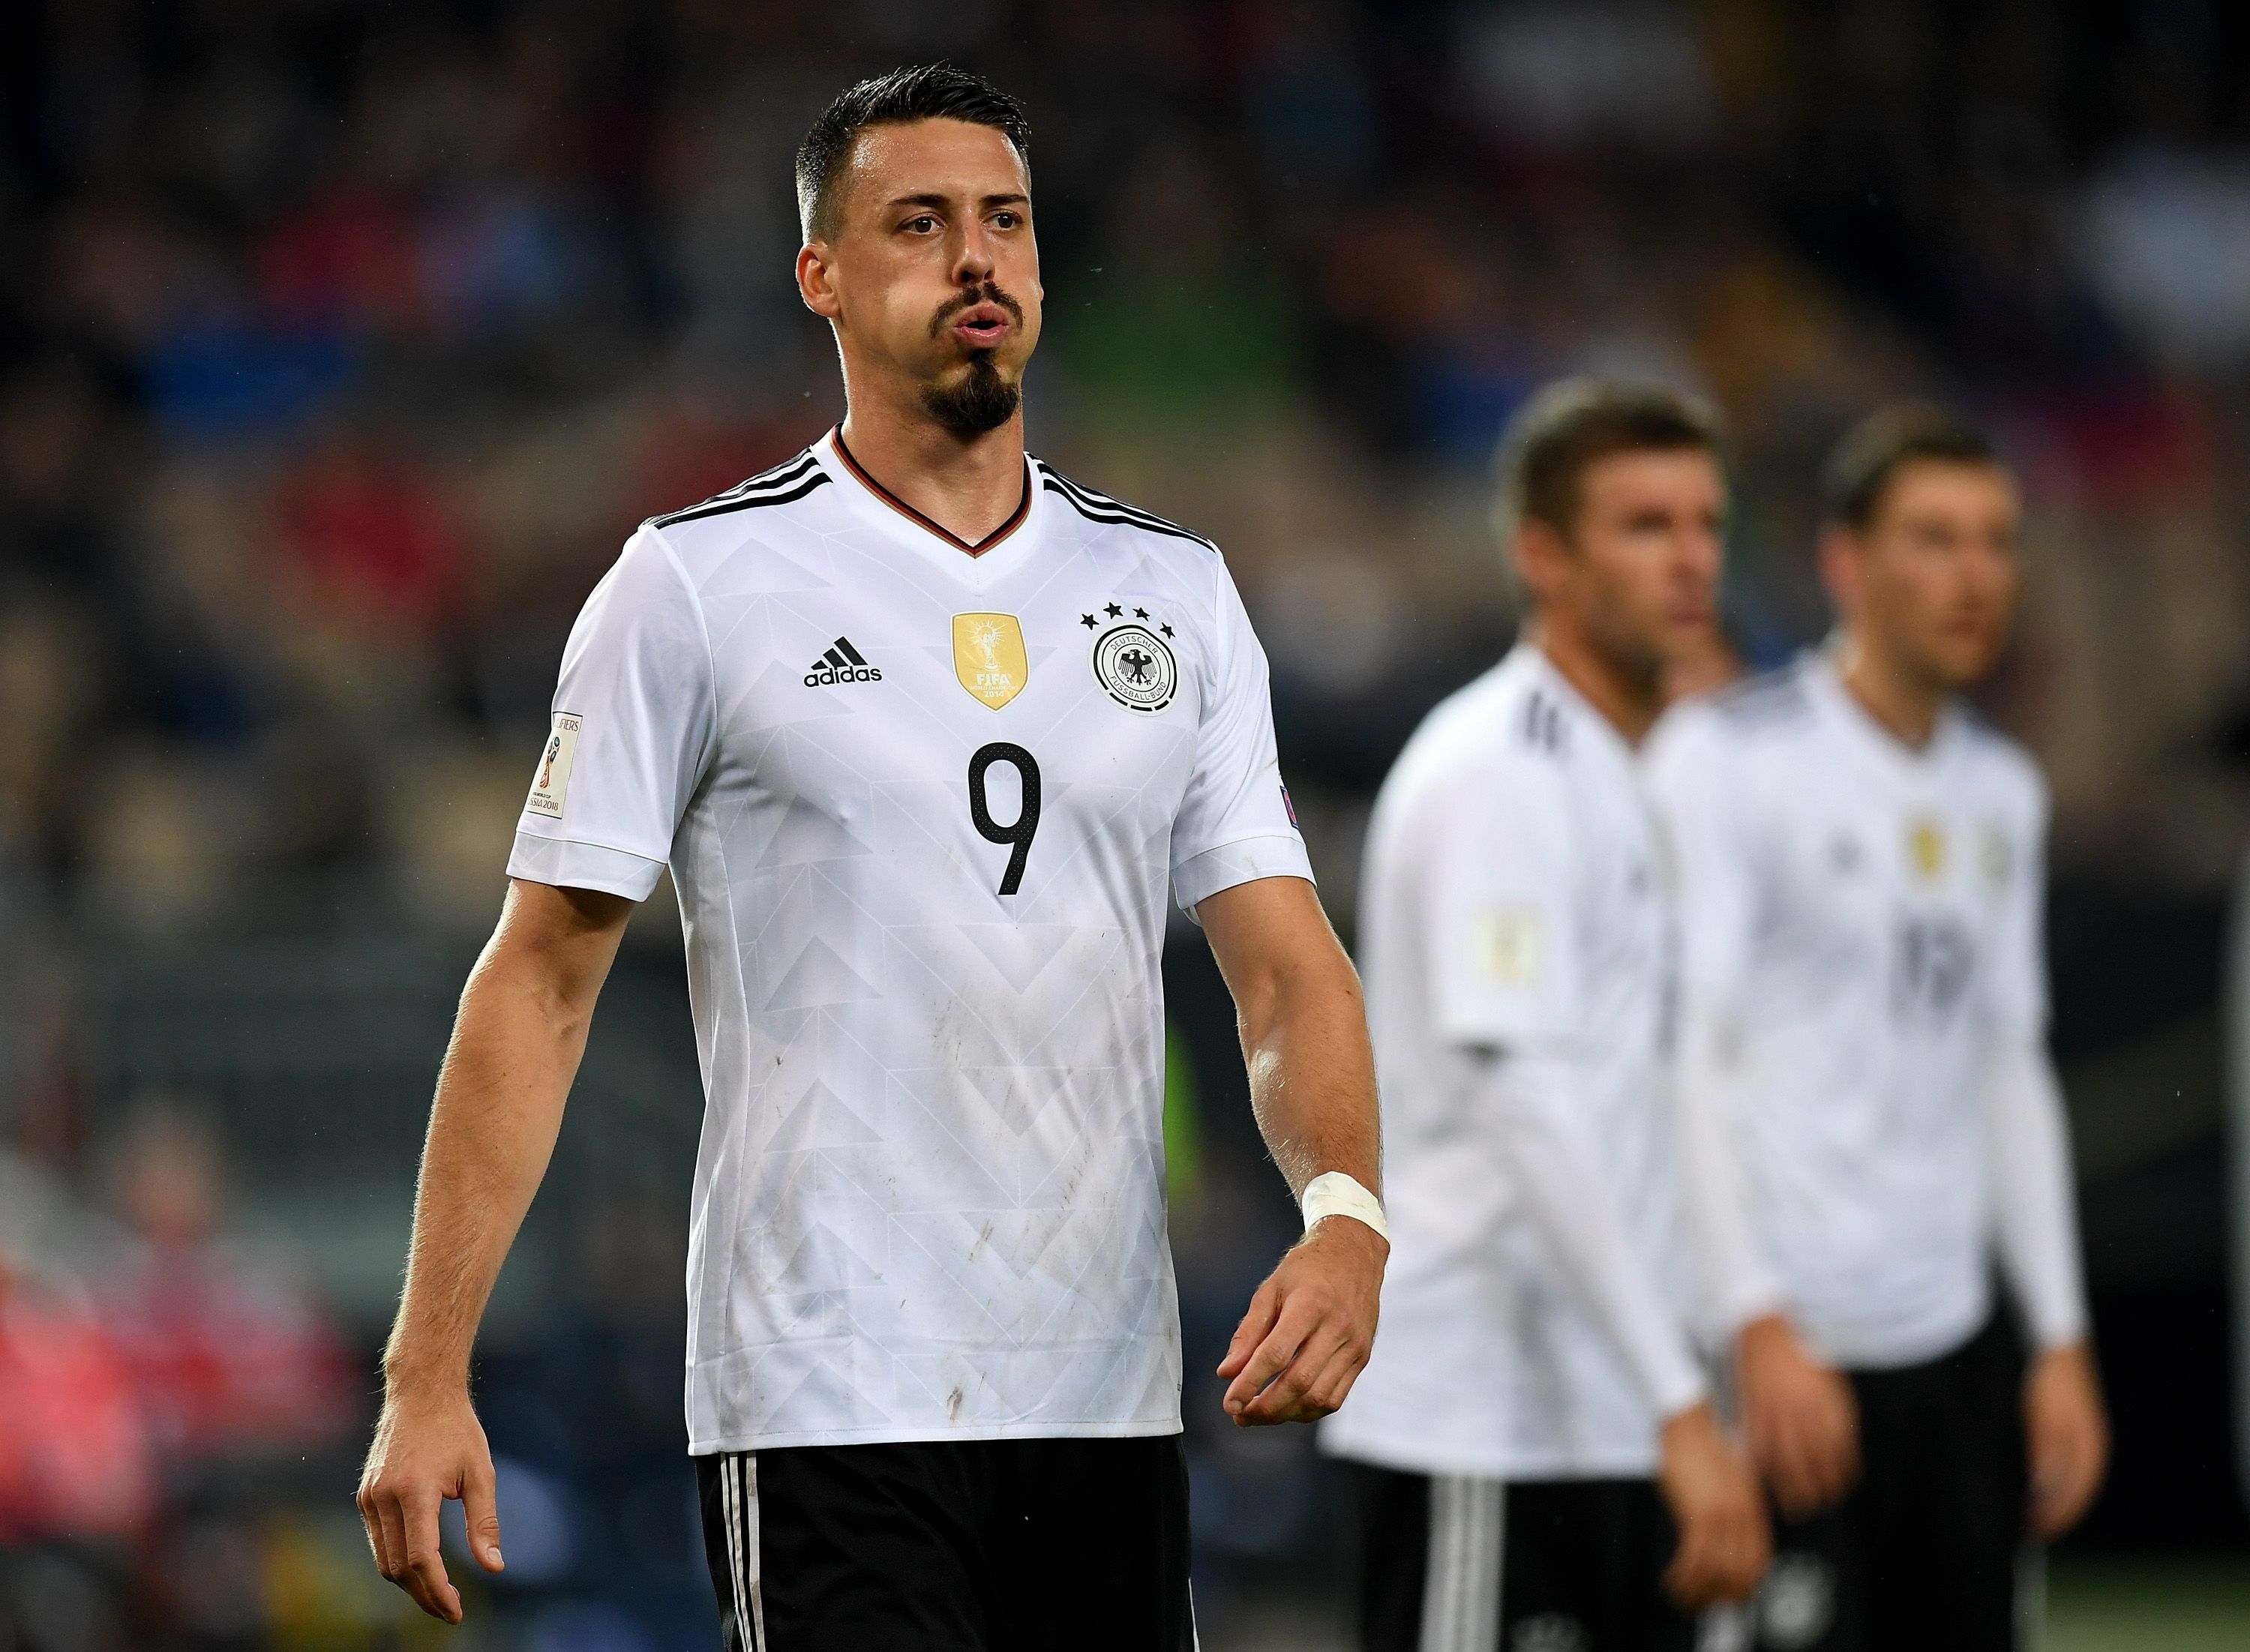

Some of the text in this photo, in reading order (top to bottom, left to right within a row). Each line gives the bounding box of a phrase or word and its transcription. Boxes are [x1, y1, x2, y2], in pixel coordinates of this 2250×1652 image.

[1110, 635, 1159, 654] DEUTSCHER
[803, 665, 883, 687] adidas
[976, 673, 1010, 685] FIFA
[542, 799, 559, 811] 2018
[968, 741, 1042, 896] 9
